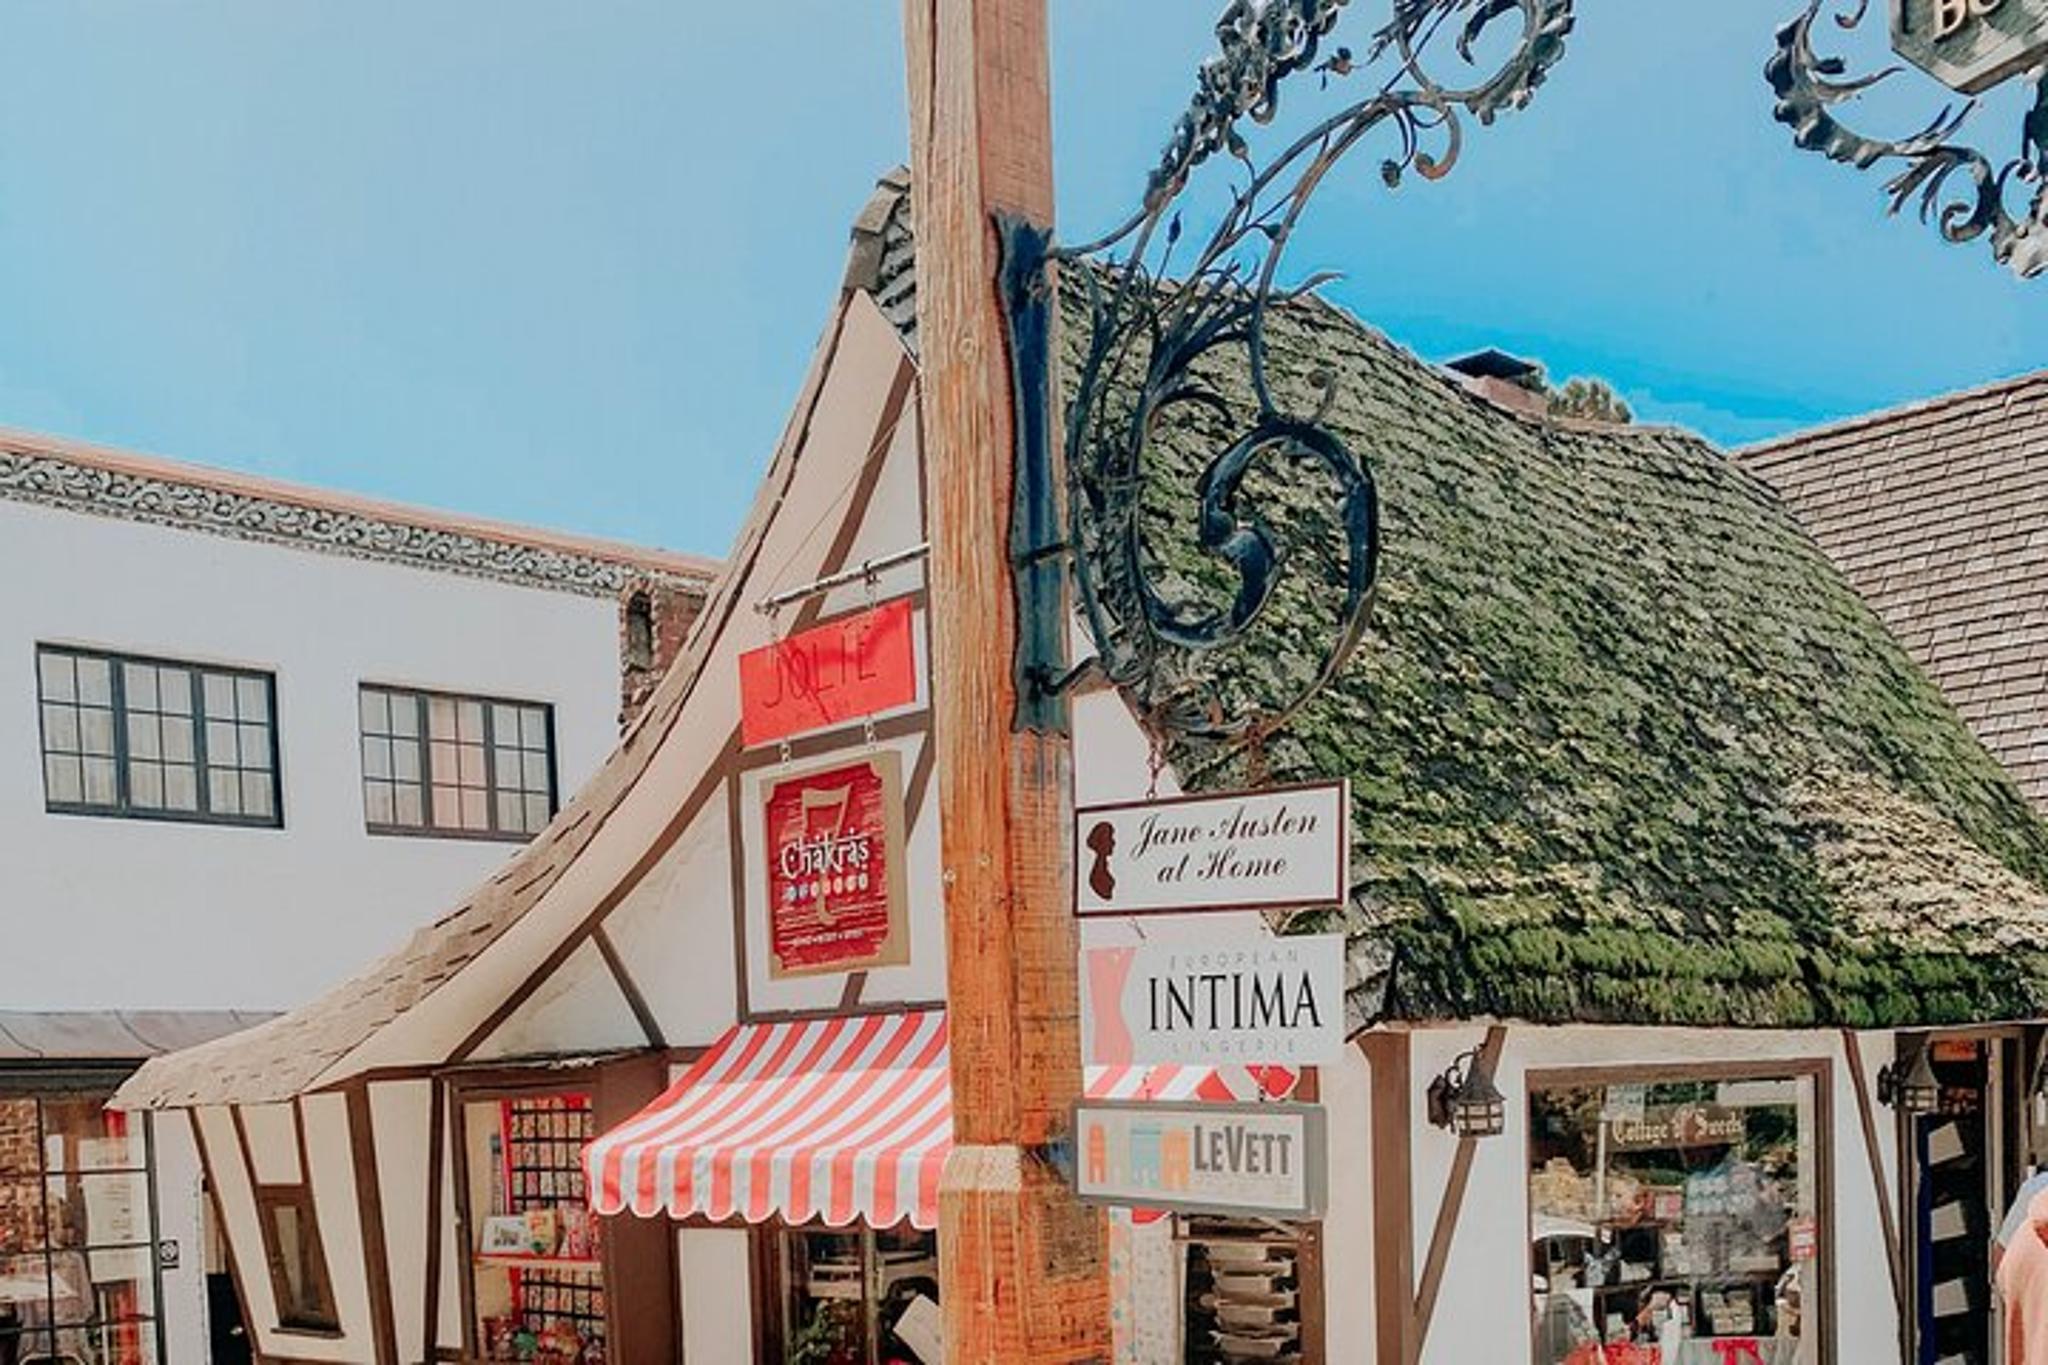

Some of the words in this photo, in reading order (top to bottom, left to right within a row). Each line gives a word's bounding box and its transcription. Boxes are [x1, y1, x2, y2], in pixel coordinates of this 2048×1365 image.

[781, 828, 871, 880] Chakras
[1131, 812, 1201, 859] Jane
[1209, 805, 1318, 842] Austen
[1156, 853, 1189, 882] at
[1197, 848, 1287, 880] Home
[1167, 949, 1298, 971] EUROPEAN
[1149, 971, 1321, 1030] INTIMA
